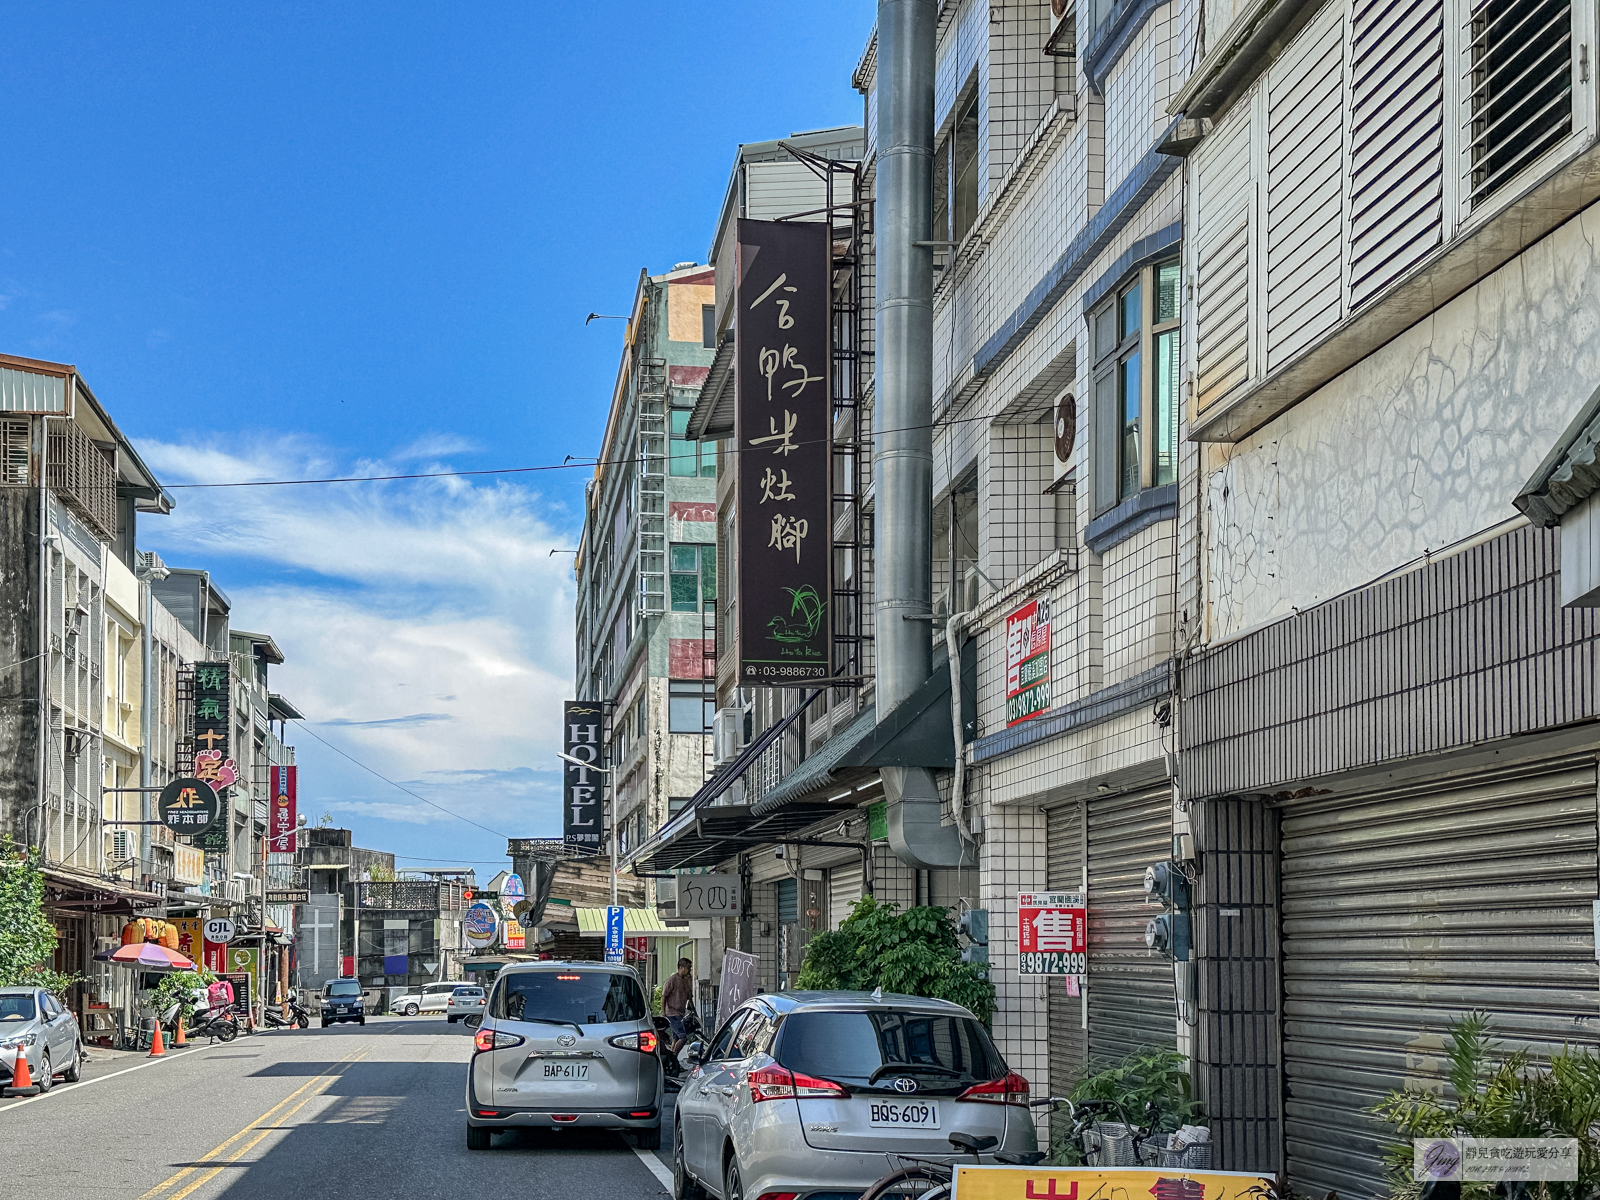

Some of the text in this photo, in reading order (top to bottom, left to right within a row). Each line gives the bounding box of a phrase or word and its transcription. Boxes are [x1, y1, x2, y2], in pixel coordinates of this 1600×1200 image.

[569, 723, 598, 826] HOTEL
[167, 814, 208, 824] 炸本部
[611, 907, 620, 916] P
[209, 922, 231, 935] CJL
[1032, 909, 1074, 951] 售
[544, 1064, 588, 1077] BAP-6117
[871, 1103, 936, 1125] BQS-6091
